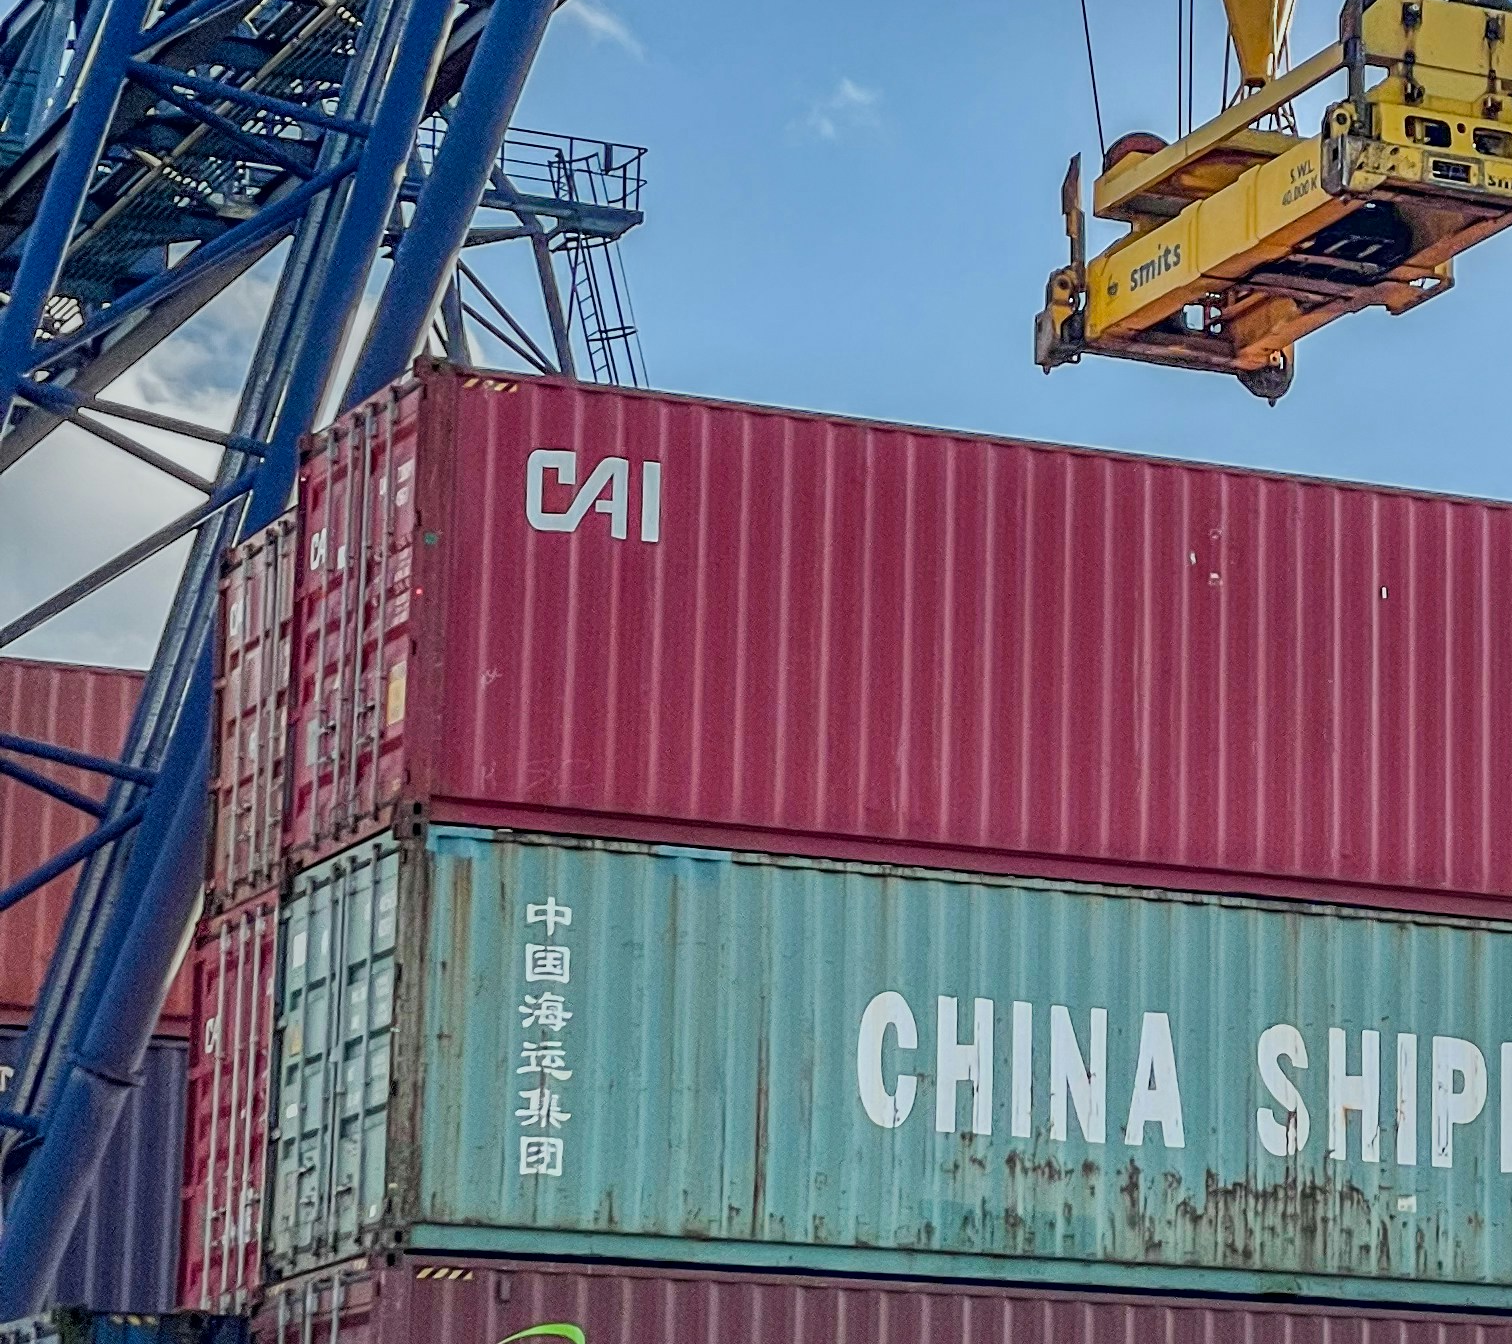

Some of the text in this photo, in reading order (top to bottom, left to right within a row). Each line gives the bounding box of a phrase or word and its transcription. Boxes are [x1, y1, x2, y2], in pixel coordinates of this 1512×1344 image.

[1130, 244, 1181, 291] smits
[526, 449, 661, 543] CAI
[310, 527, 328, 571] CA
[857, 990, 1186, 1149] CHINA
